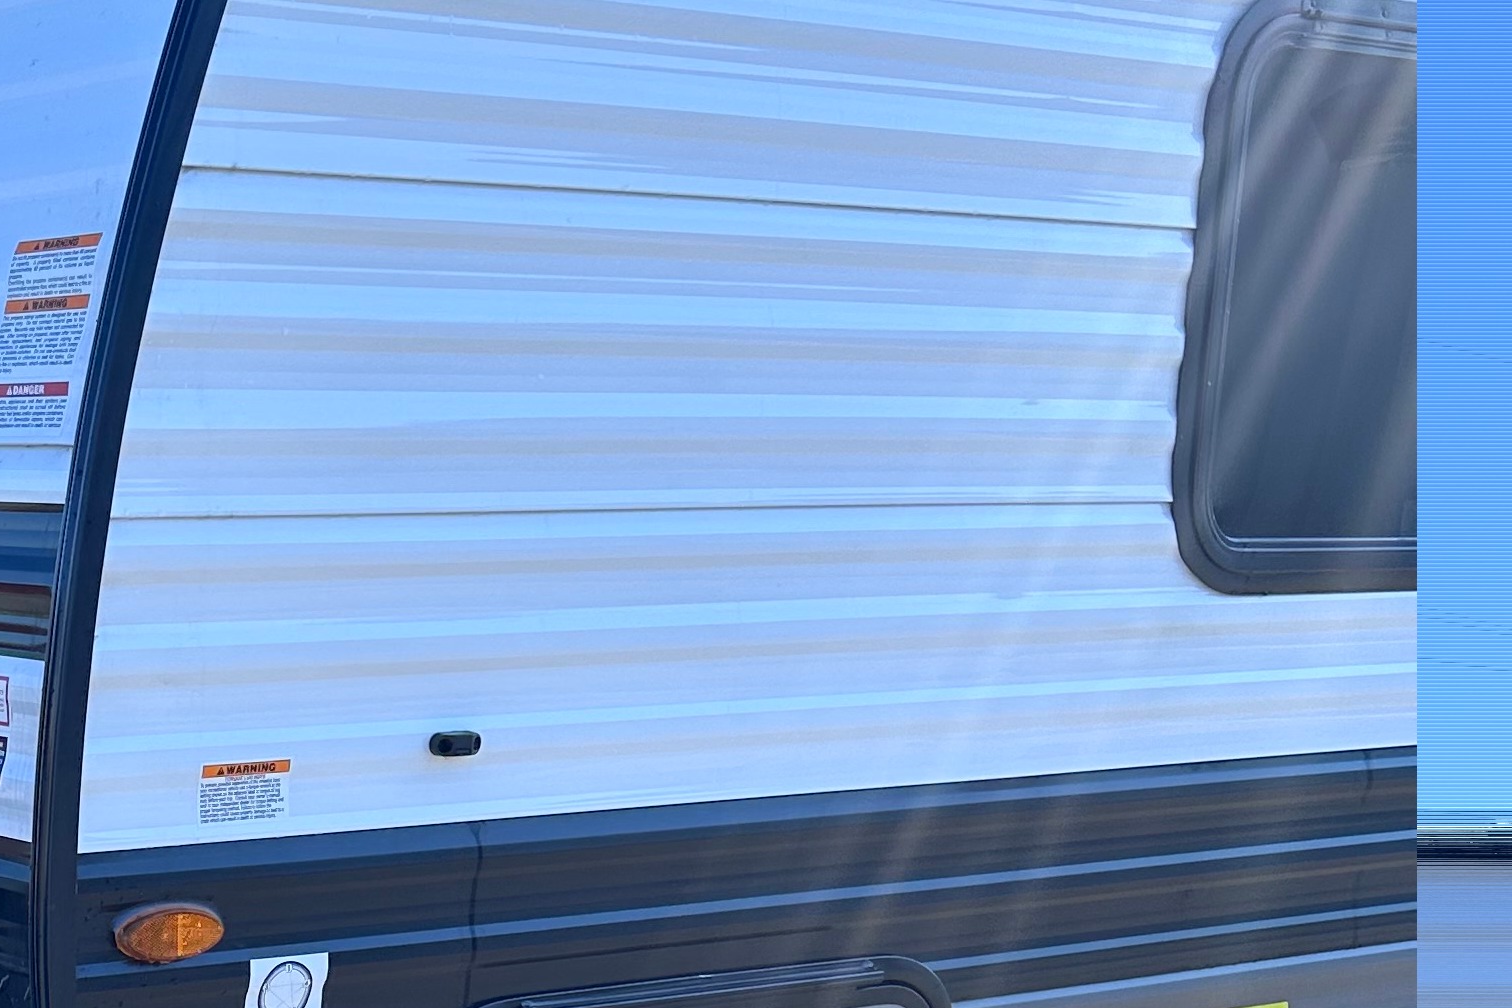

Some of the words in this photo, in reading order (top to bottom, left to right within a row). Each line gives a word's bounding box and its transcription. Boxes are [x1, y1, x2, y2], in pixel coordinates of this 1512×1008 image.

[43, 237, 80, 249] WARNING
[32, 298, 68, 310] WARNING
[13, 384, 45, 395] DANGER
[226, 763, 277, 775] WARNING
